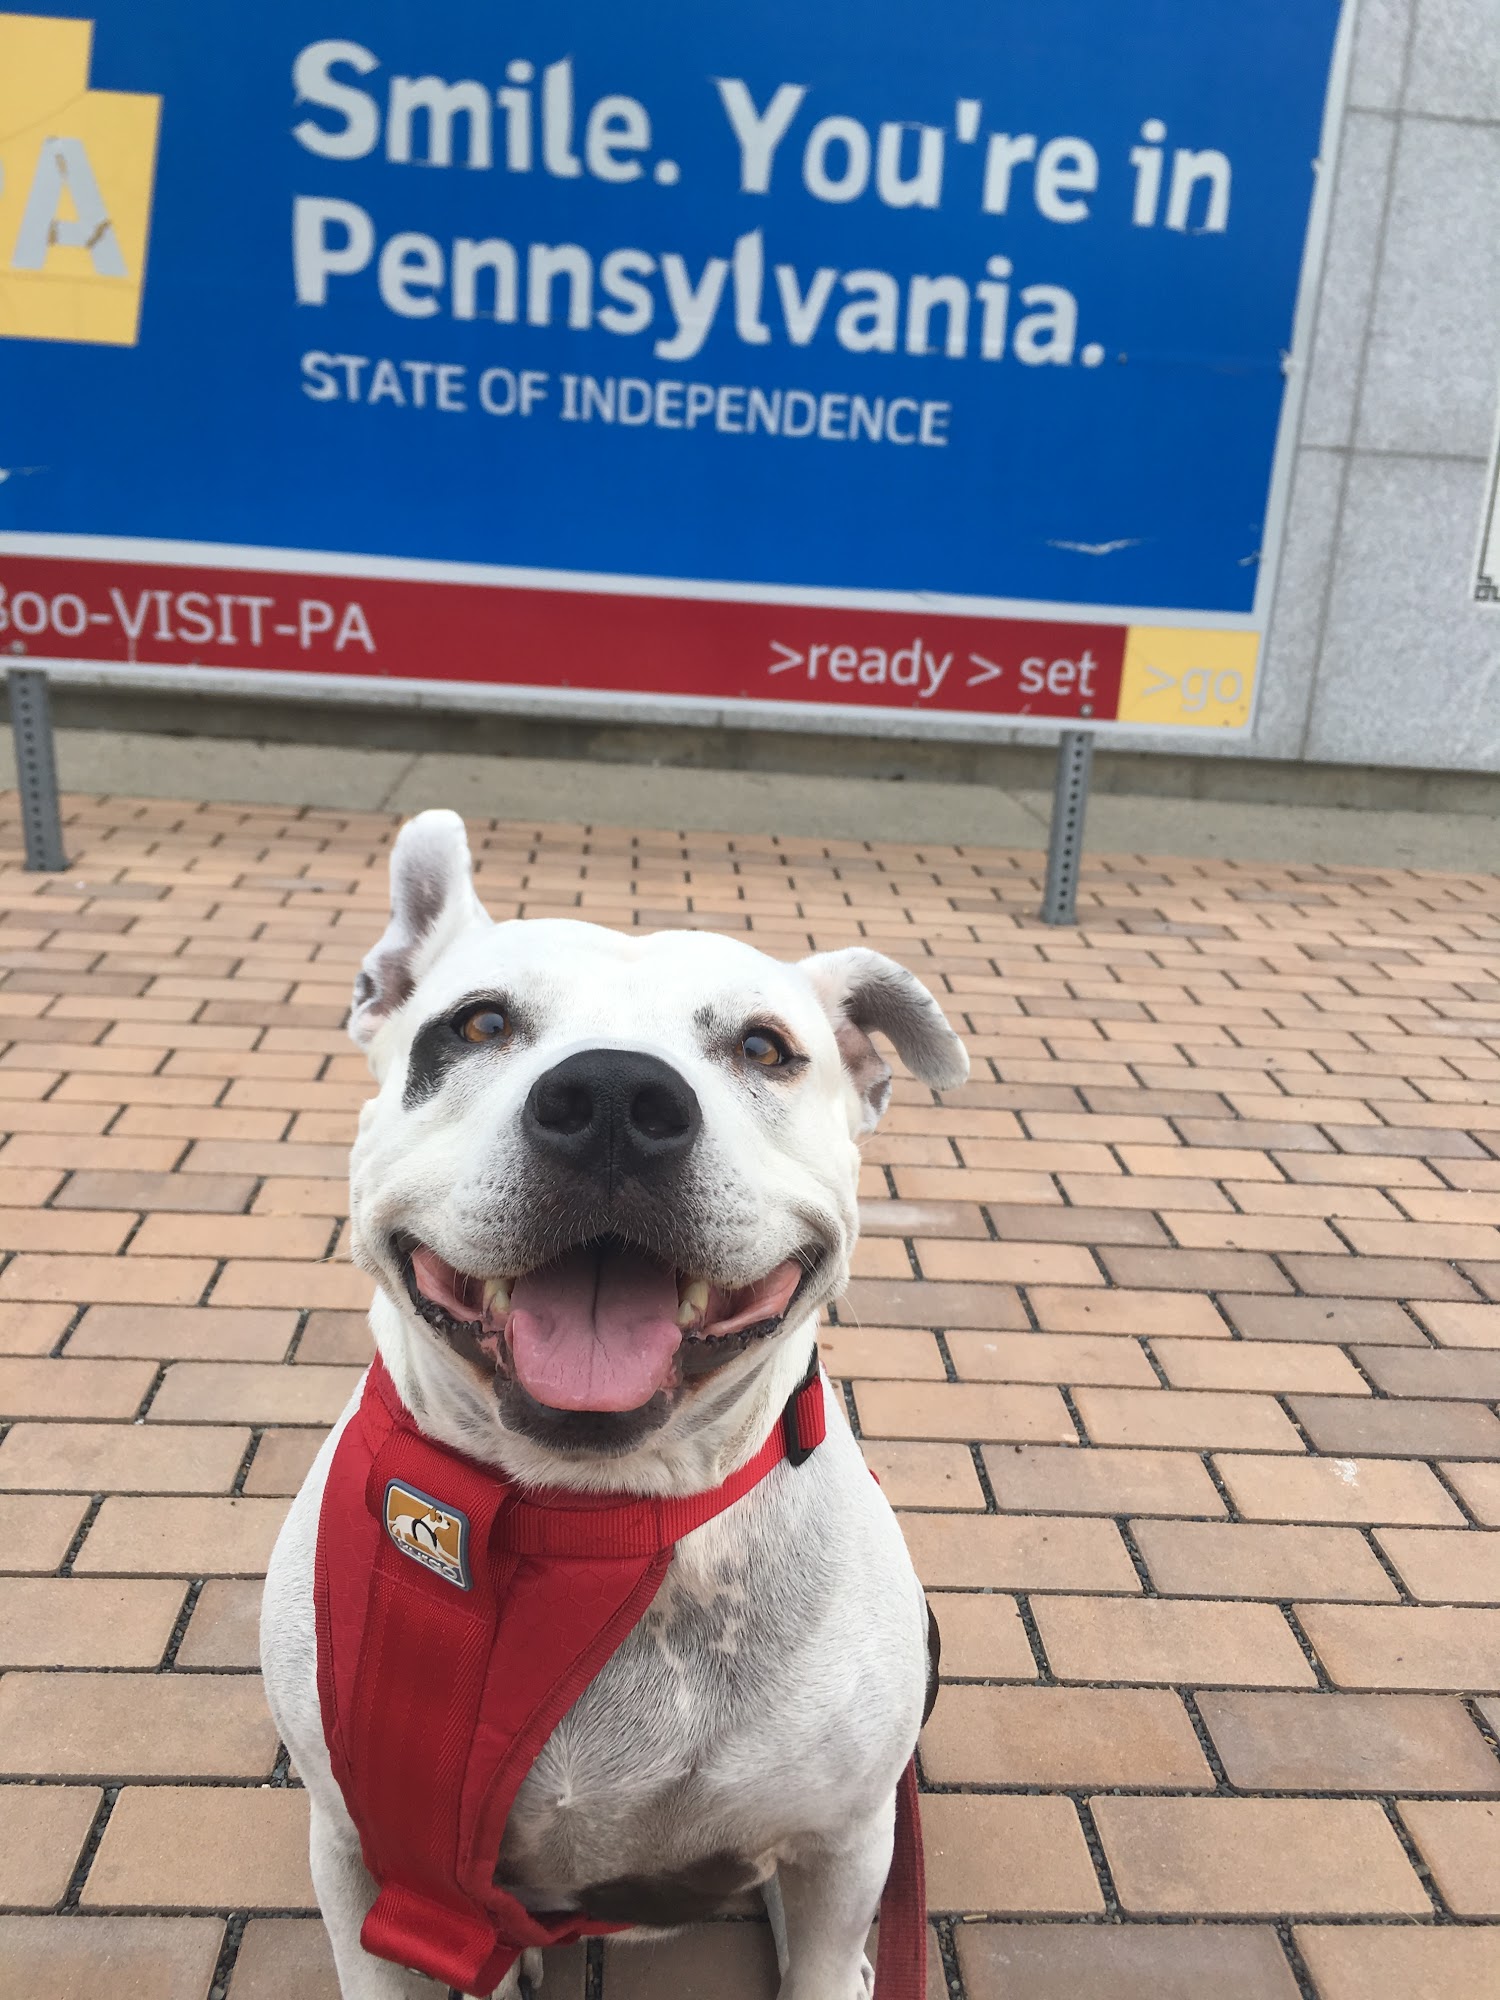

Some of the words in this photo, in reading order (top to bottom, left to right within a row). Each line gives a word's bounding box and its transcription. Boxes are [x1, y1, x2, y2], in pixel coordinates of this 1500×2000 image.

[292, 39, 680, 185] Smile.
[715, 76, 1100, 224] You're
[1130, 118, 1233, 233] in
[0, 135, 129, 278] A
[292, 195, 1105, 367] Pennsylvania.
[302, 351, 466, 411] STATE
[480, 367, 548, 416] OF
[561, 374, 951, 446] INDEPENDENCE
[0, 584, 376, 654] 00-VISIT-PA
[1017, 649, 1098, 698] set
